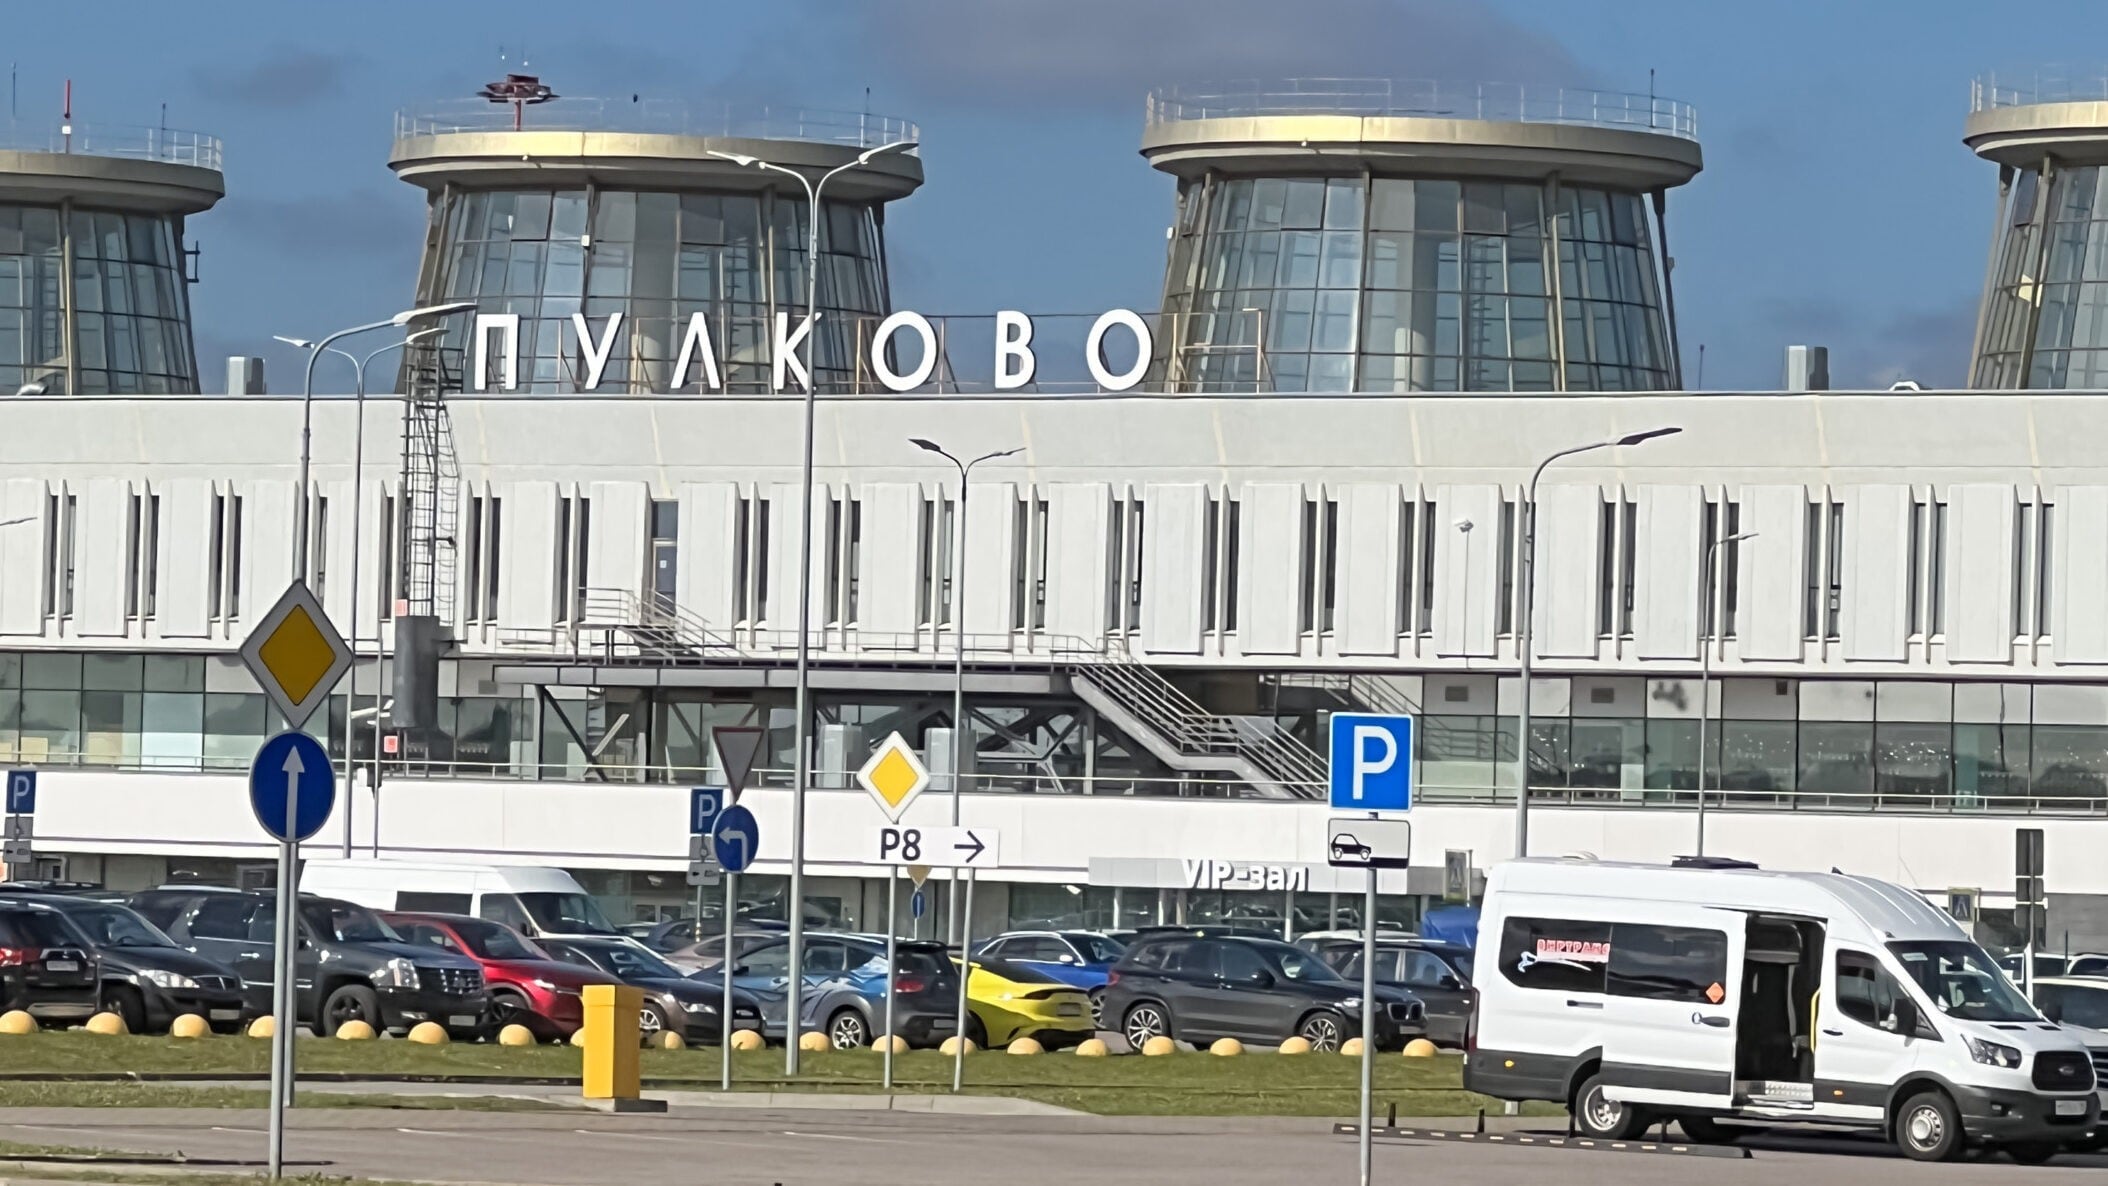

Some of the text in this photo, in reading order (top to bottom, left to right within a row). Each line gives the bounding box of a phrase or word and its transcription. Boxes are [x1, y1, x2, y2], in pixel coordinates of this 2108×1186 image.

[474, 308, 1153, 392] ПУЛКОВО
[1352, 725, 1398, 800] P
[13, 774, 30, 809] P
[697, 793, 716, 830] P
[880, 828, 922, 861] P8
[1181, 859, 1309, 892] VIP-зал
